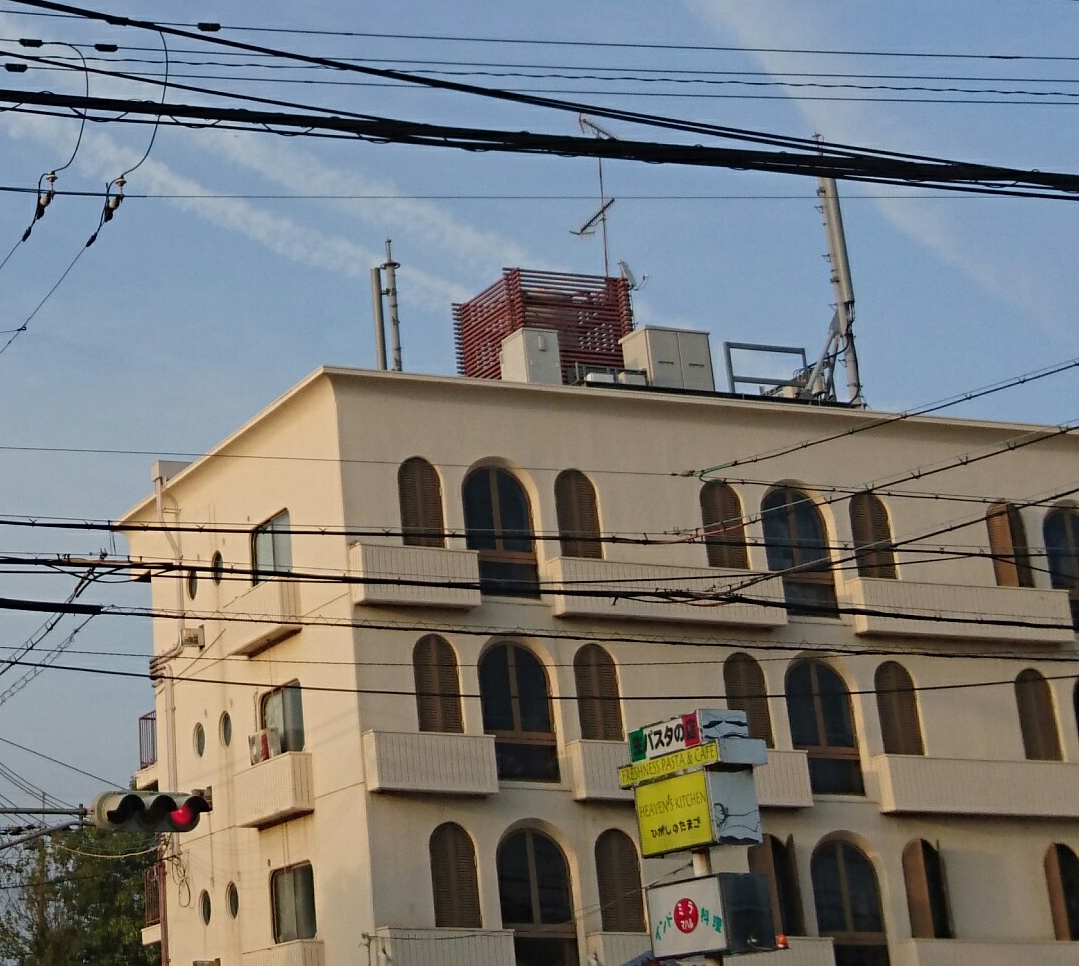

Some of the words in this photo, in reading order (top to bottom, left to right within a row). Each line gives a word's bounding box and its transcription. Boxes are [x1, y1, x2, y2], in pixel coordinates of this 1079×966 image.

[622, 758, 660, 782] FRESHNESS
[661, 754, 685, 771] PASTA
[687, 754, 693, 765] &
[694, 745, 715, 762] CAFE
[639, 794, 674, 818] HEAVEN'S
[675, 791, 707, 809] KITCHEN
